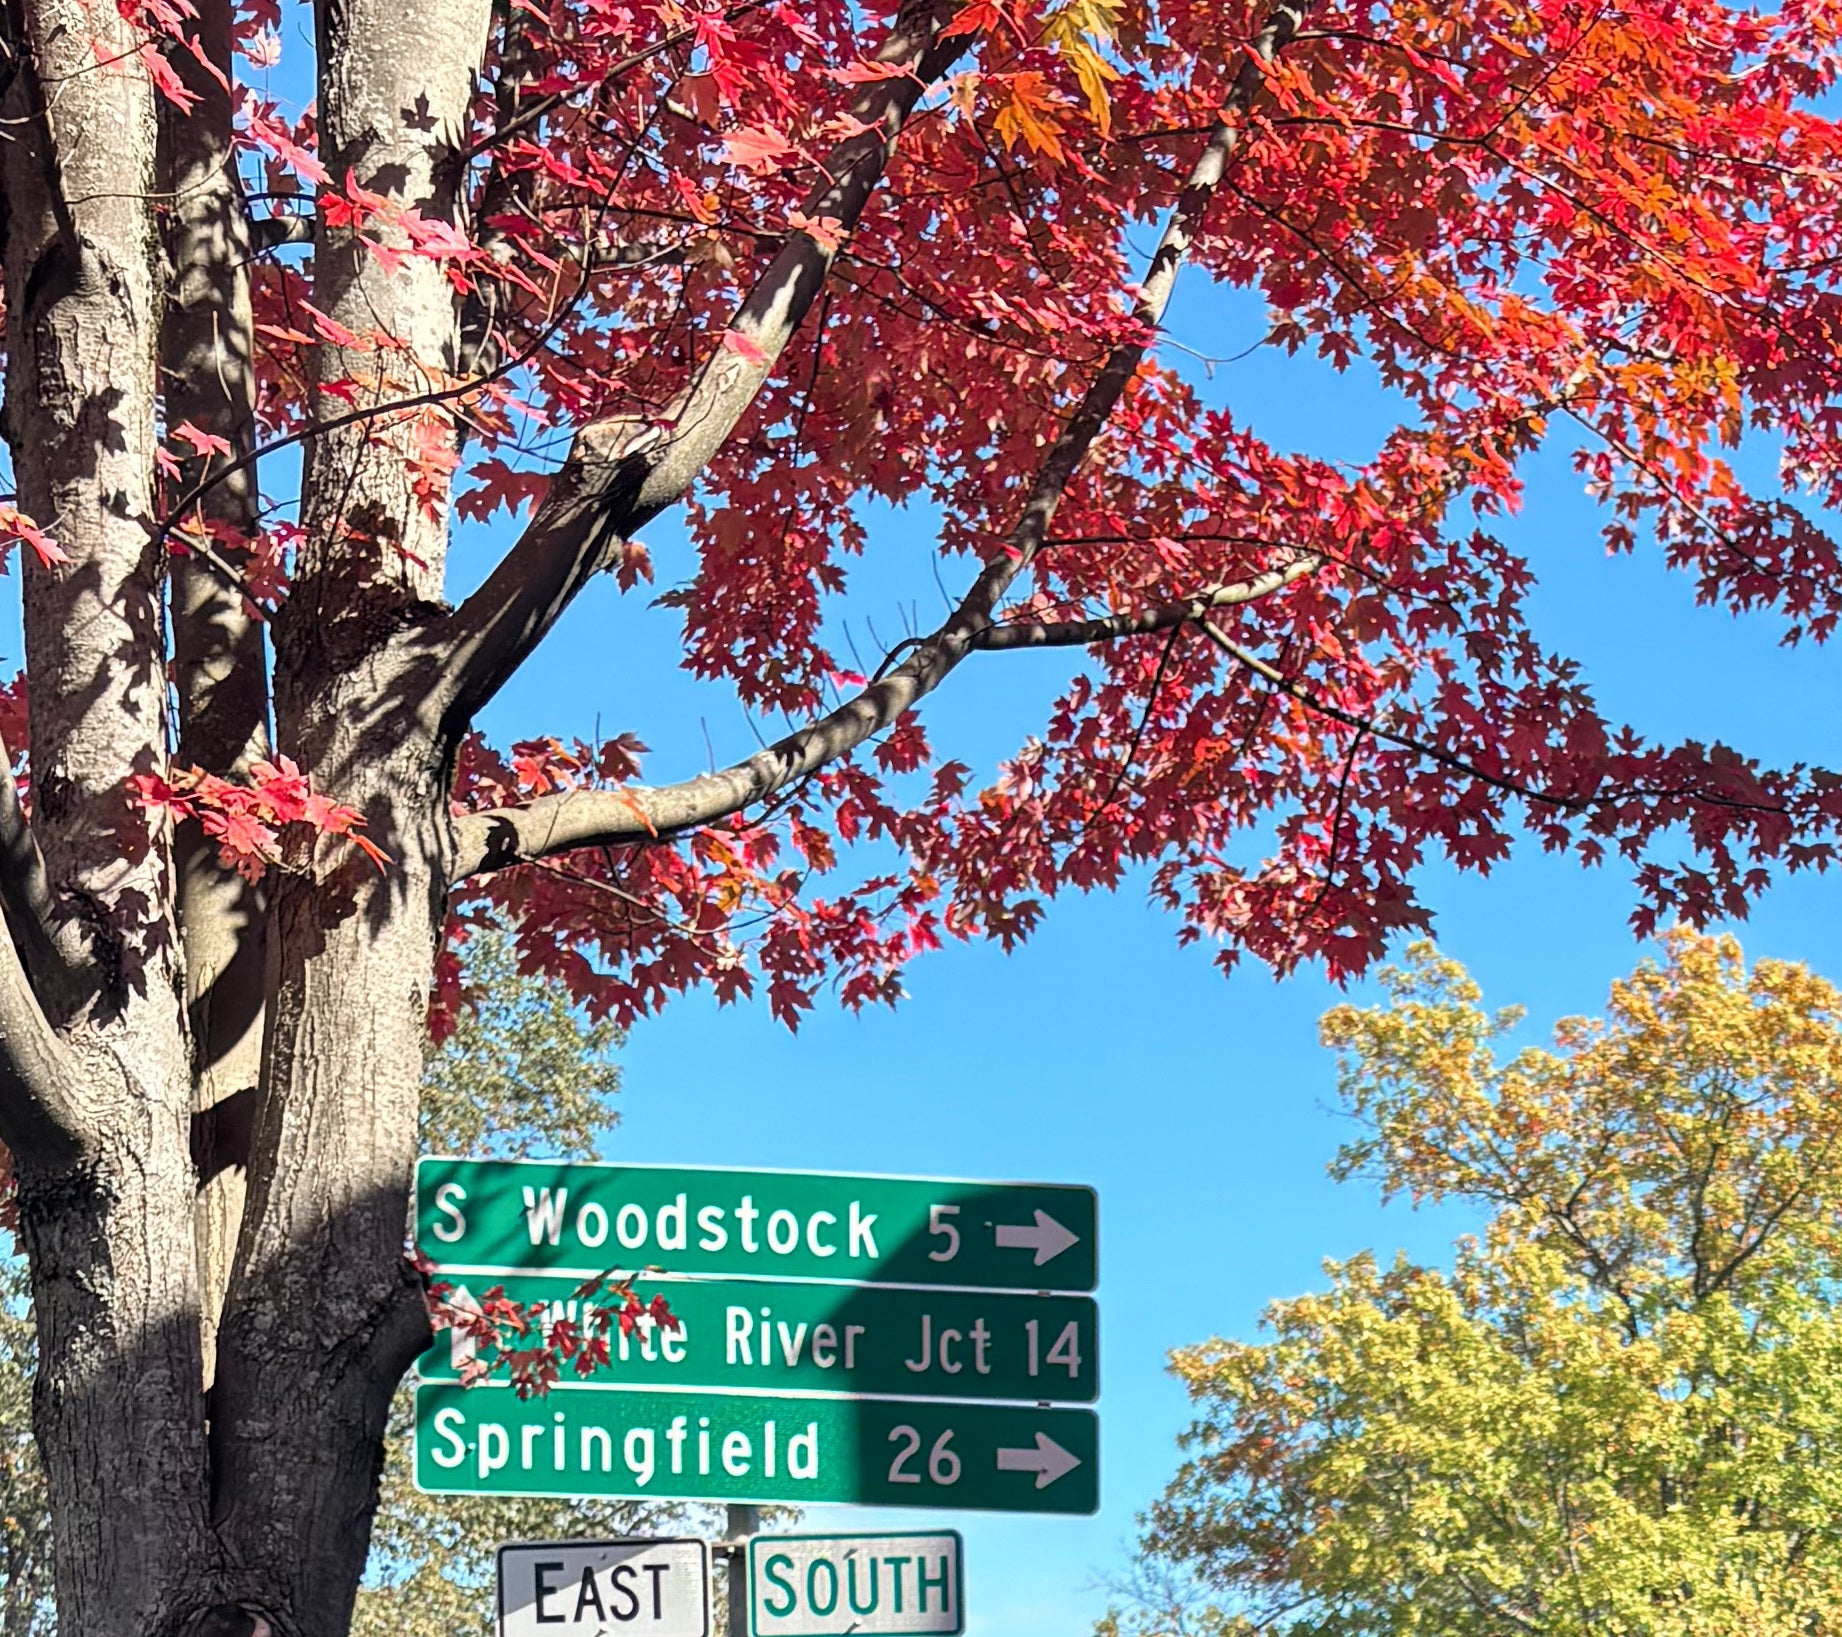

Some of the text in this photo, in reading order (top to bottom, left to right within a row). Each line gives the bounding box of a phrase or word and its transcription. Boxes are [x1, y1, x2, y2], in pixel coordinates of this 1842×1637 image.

[432, 1183, 961, 1263] S Woodstock 5
[725, 1306, 865, 1369] River
[904, 1314, 992, 1375] Jct
[1024, 1319, 1082, 1378] 14
[431, 1407, 961, 1487] Springfield 26
[534, 1562, 670, 1624] EAST
[764, 1553, 949, 1618] SOUTH
